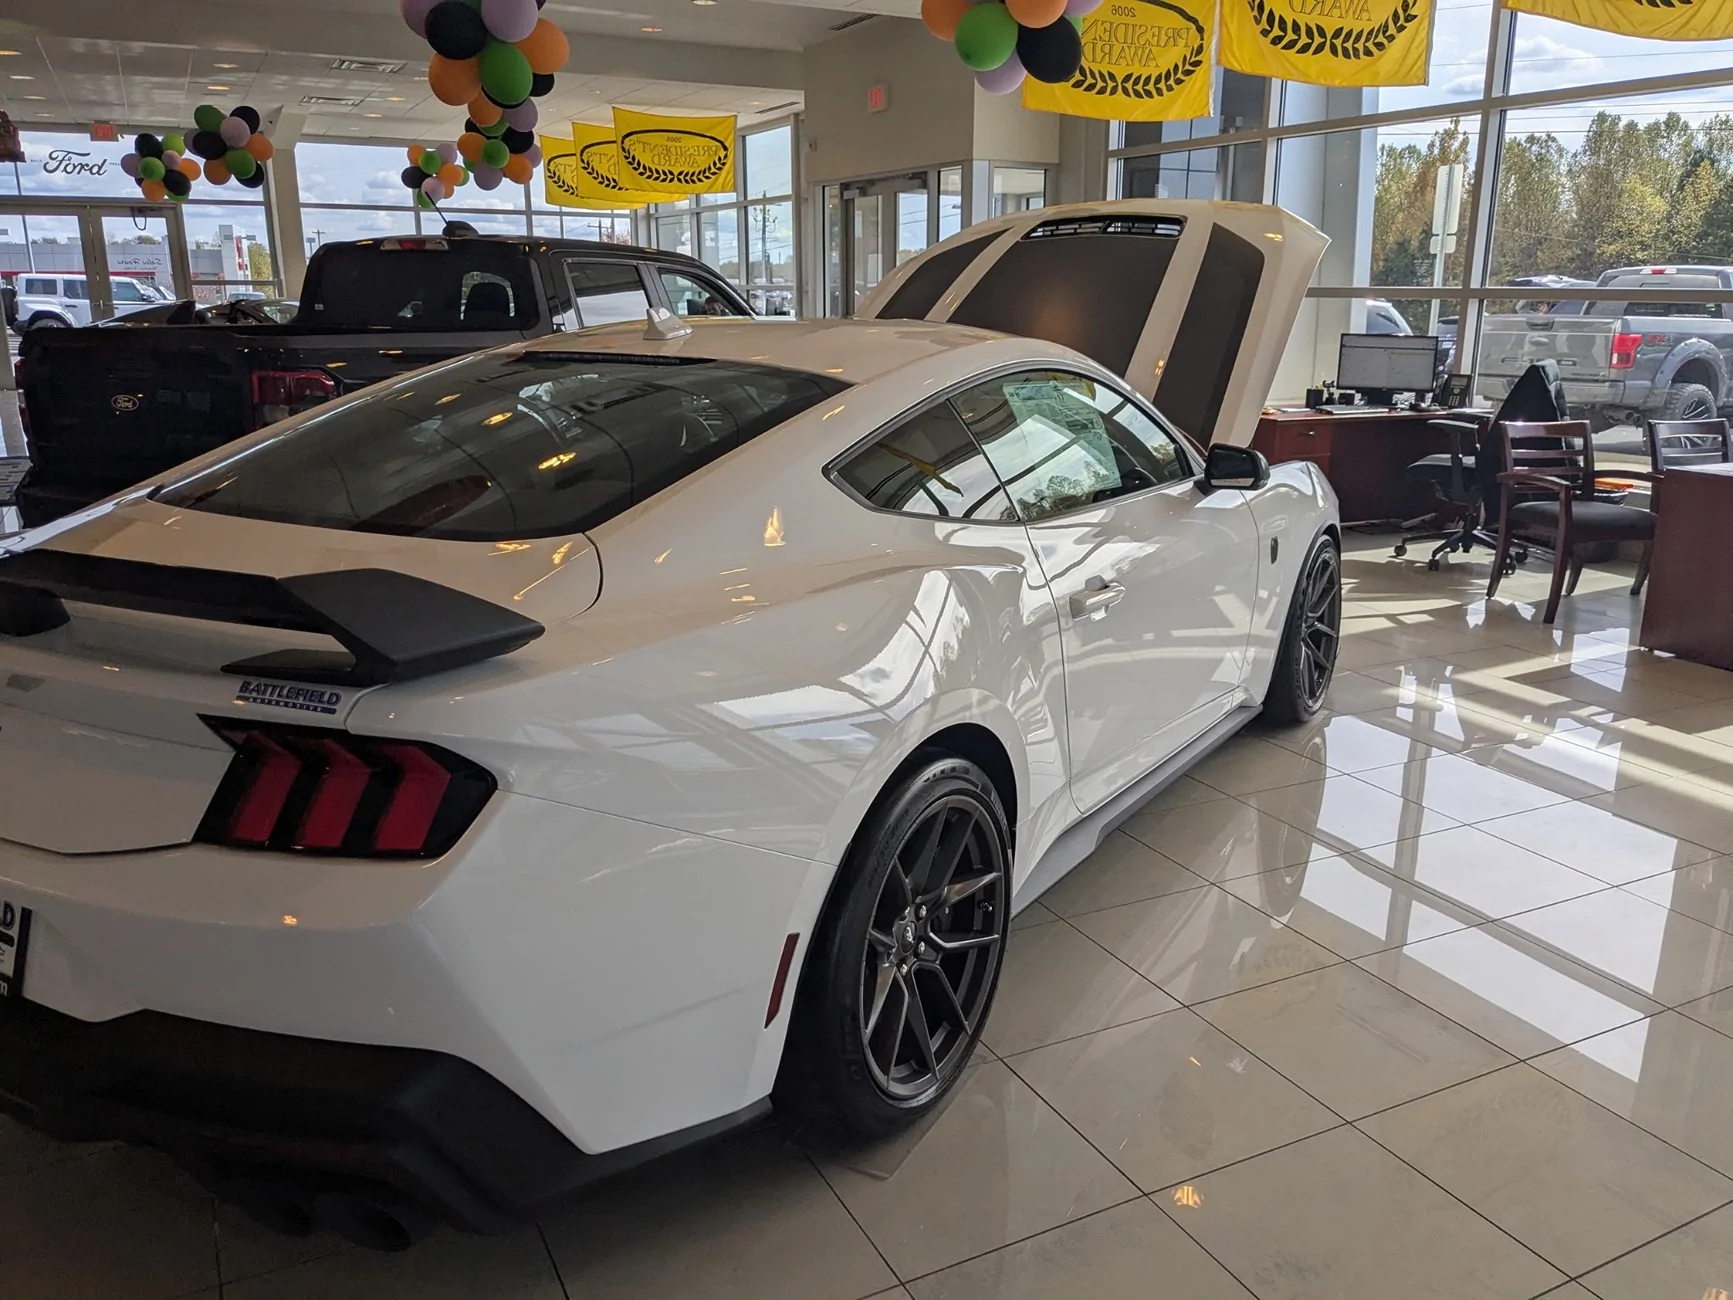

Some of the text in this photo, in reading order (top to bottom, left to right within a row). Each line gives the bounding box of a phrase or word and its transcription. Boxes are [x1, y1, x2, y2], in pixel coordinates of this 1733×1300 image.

[43, 149, 108, 176] Ford
[238, 680, 342, 706] BATTLEFIELD
[249, 696, 322, 712] AUTOMOTIVE
